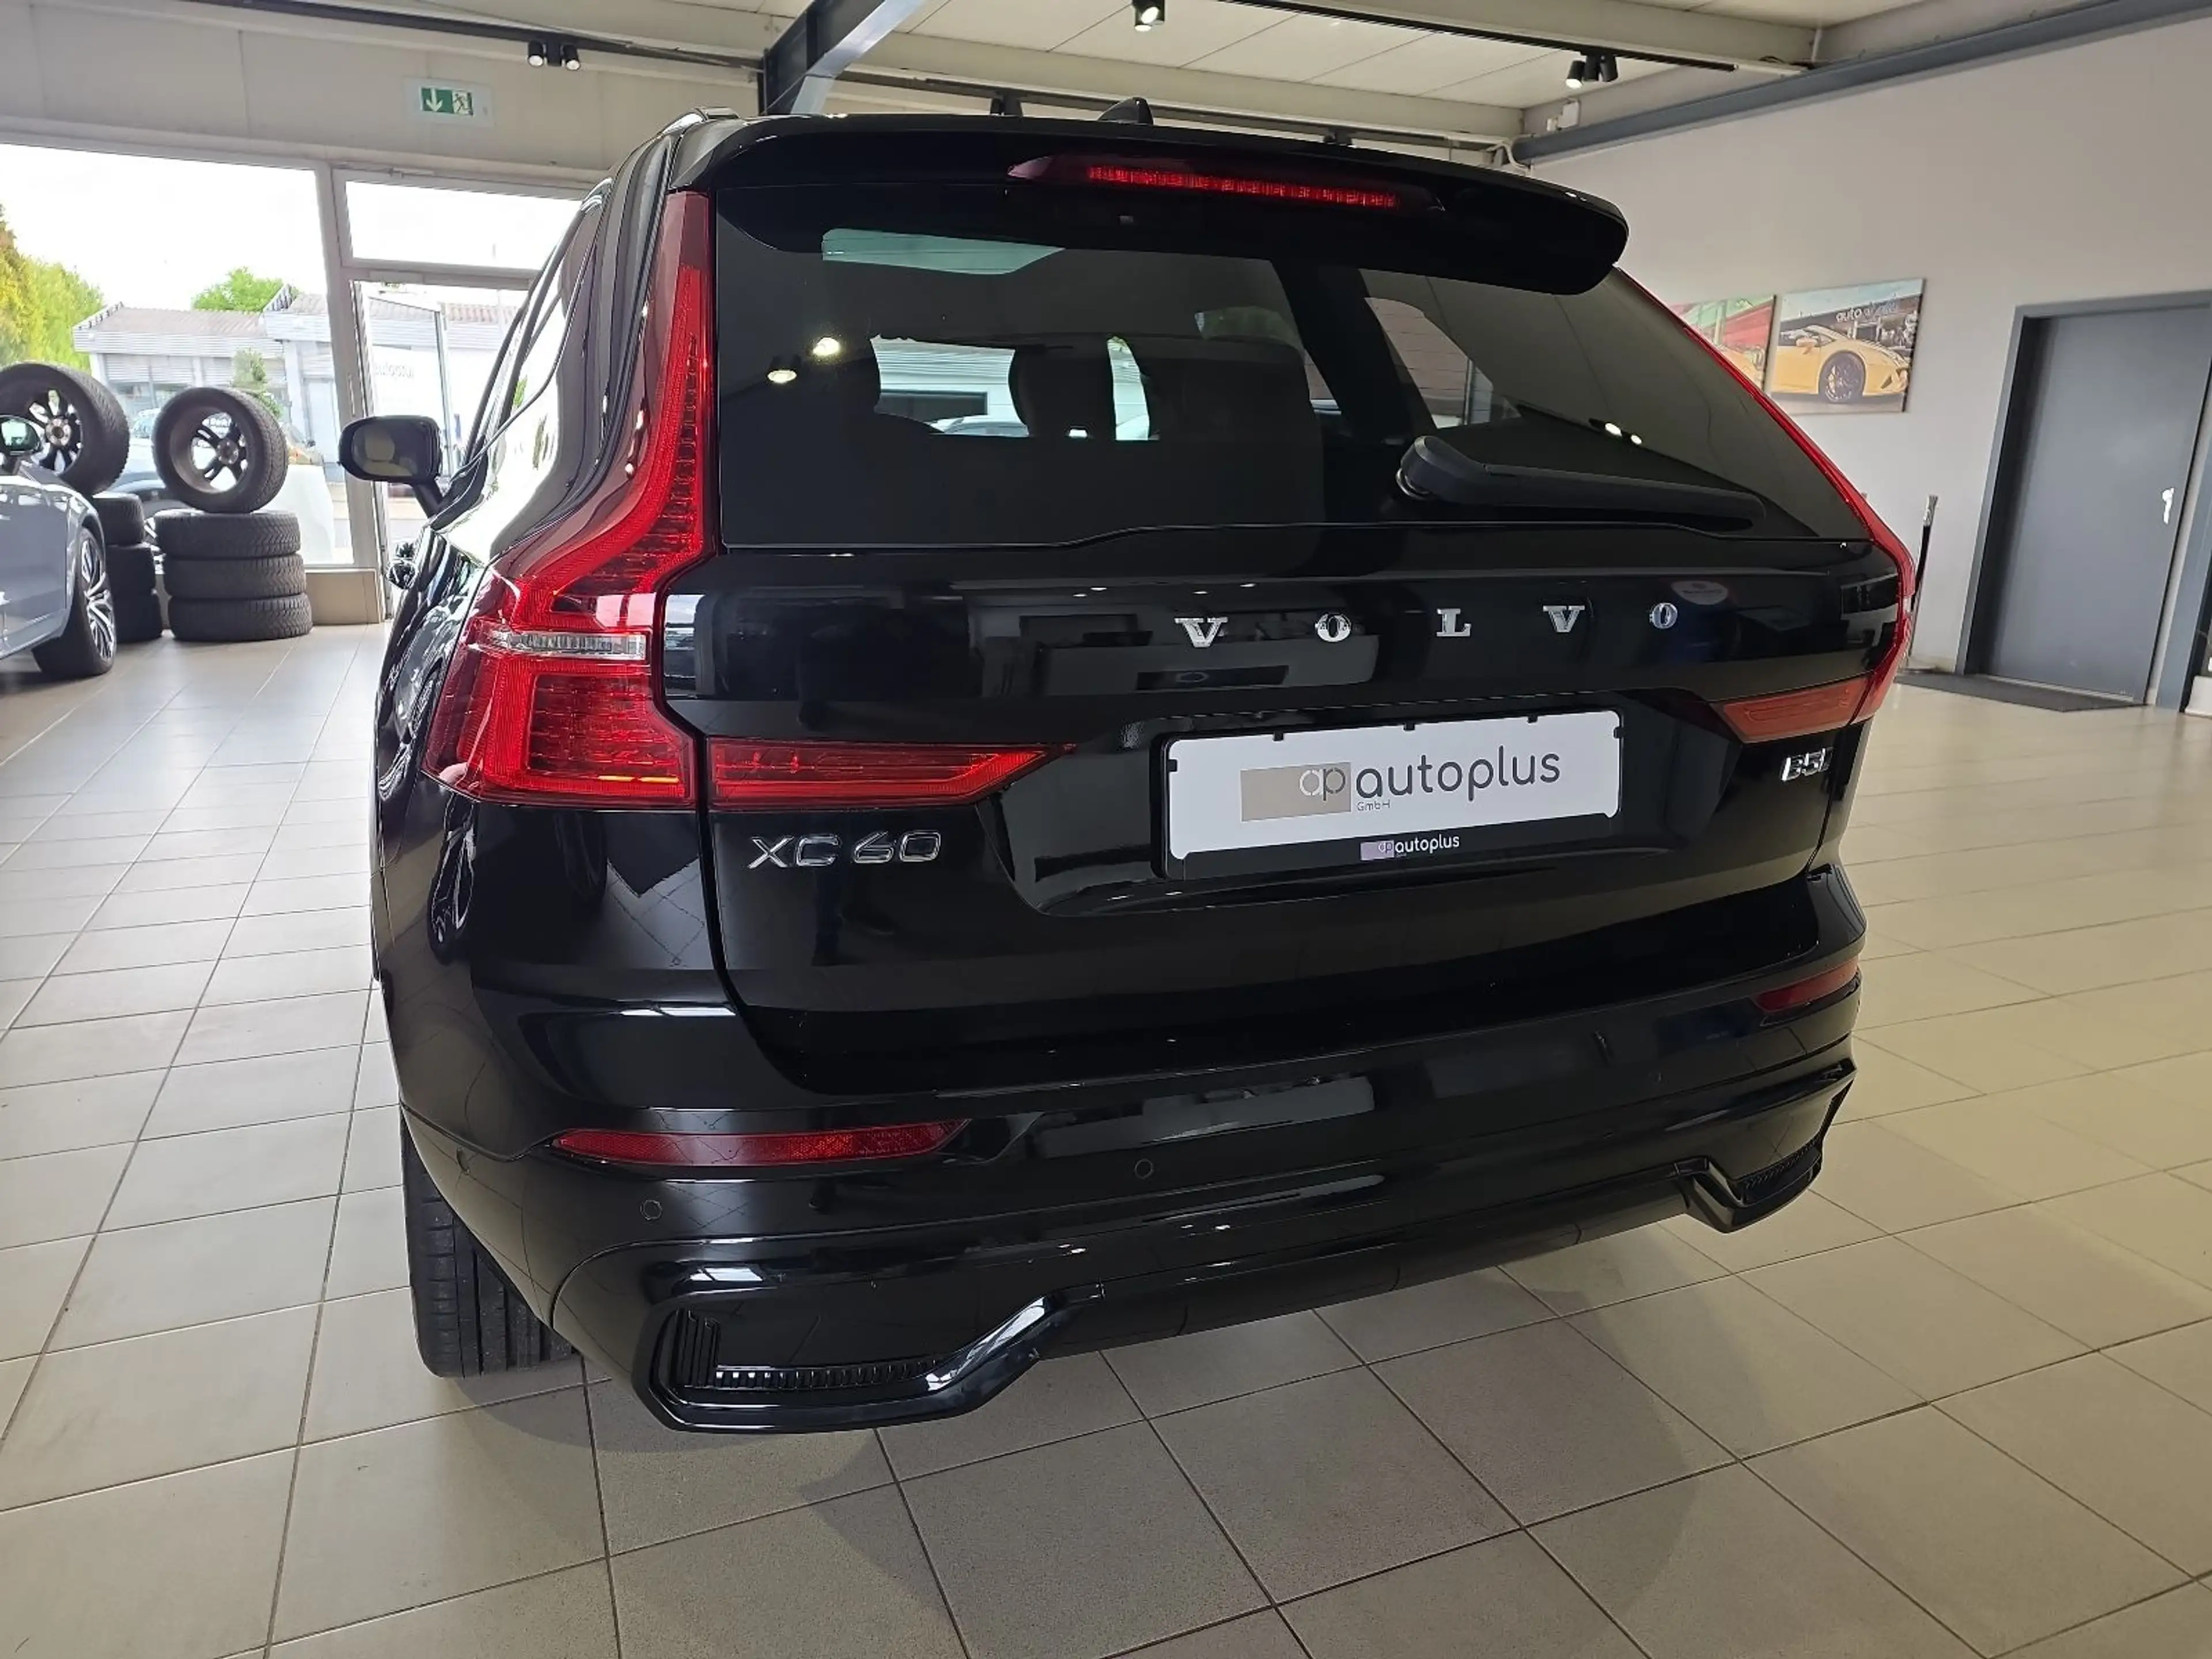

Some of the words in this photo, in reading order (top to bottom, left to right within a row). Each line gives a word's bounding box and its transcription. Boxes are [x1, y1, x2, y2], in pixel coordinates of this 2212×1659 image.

[1173, 602, 1679, 649] VOLVO
[1355, 745, 1561, 802] autoplus
[1395, 834, 1460, 854] autoplus
